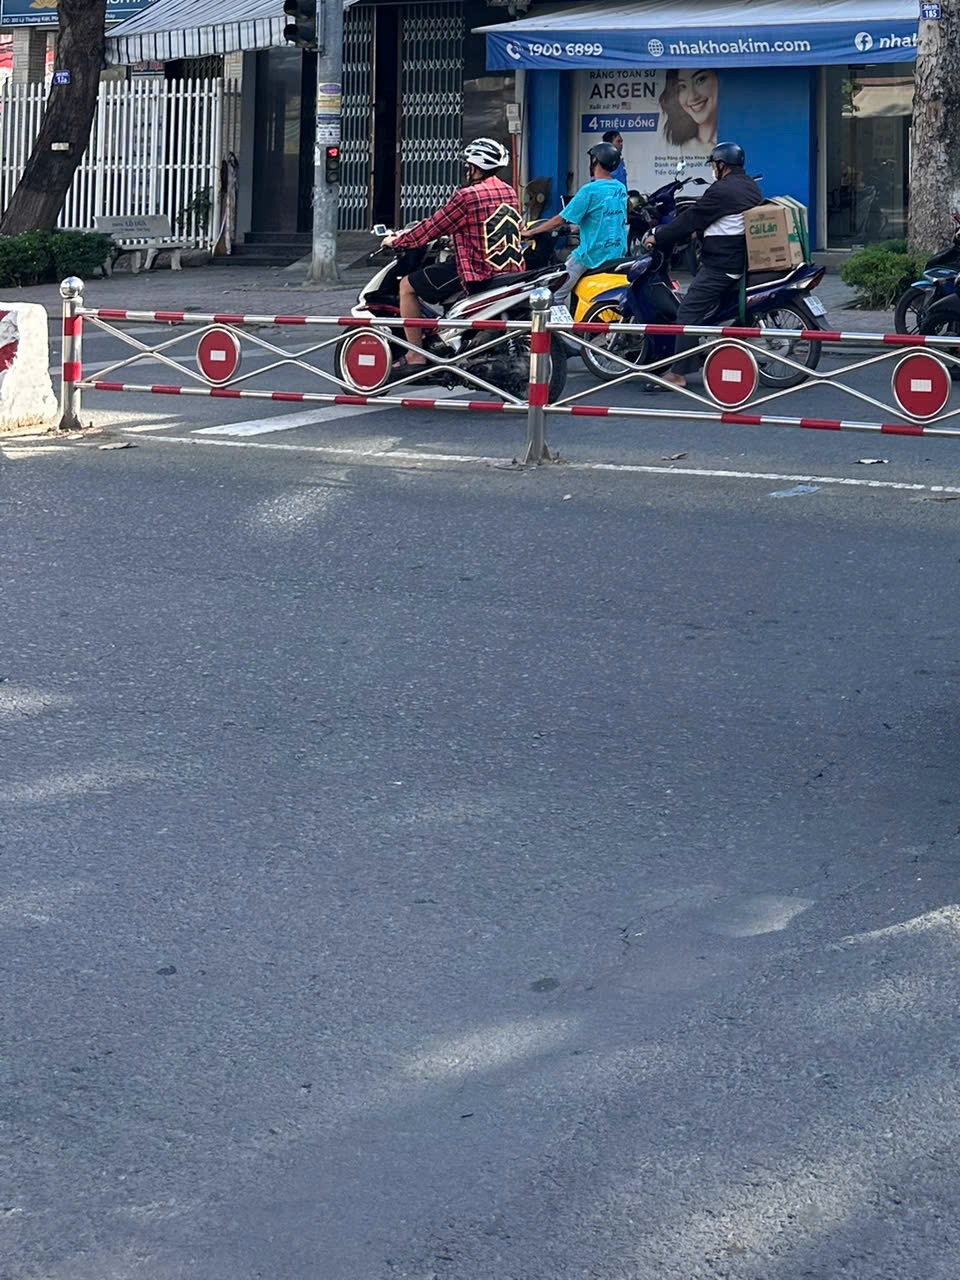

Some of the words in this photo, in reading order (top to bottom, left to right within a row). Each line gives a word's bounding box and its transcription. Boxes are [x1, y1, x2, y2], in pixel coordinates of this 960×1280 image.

[528, 42, 562, 57] 1900
[566, 42, 603, 57] 6899
[669, 37, 811, 57] nhakhoakim.com
[590, 82, 656, 99] ARGEN
[588, 116, 599, 130] 4
[600, 118, 625, 129] TRIỆU
